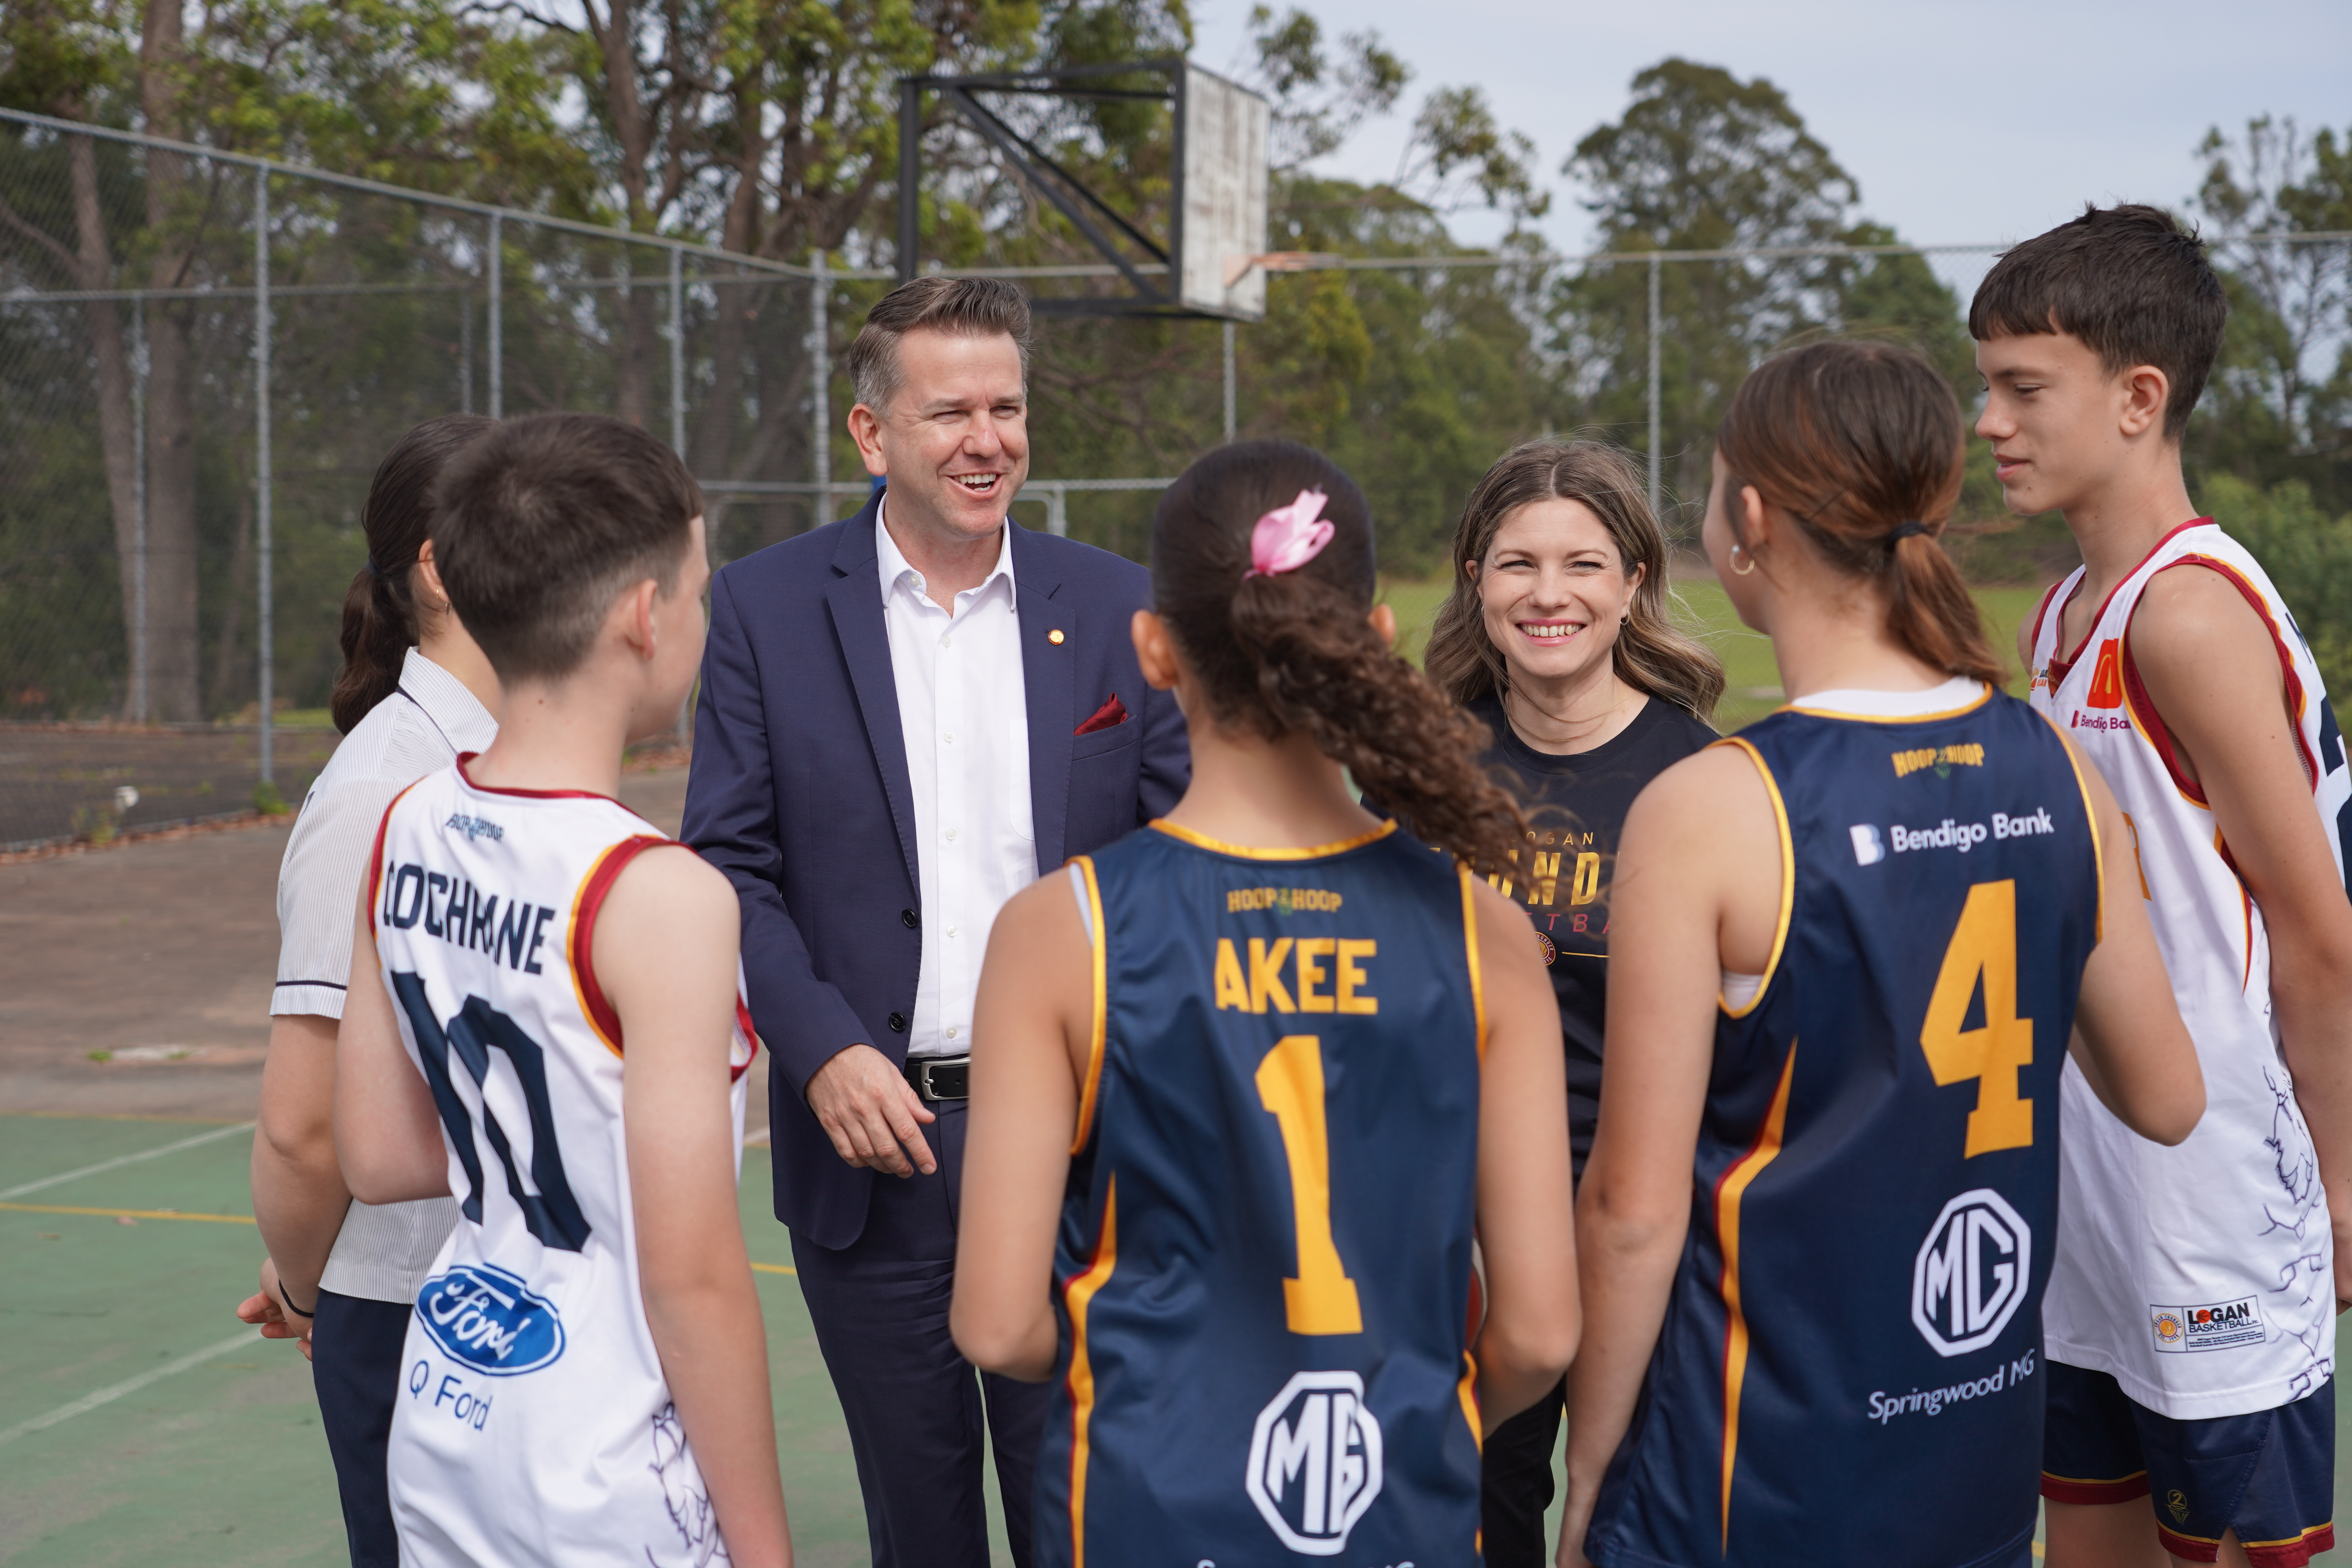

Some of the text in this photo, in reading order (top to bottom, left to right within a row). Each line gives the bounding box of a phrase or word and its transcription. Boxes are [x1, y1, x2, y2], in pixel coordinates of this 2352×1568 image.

[1890, 818, 1987, 853] Bendigo
[1991, 806, 2055, 840] Bank
[1214, 937, 1378, 1015] AKEE
[1534, 933, 1554, 951] HUNDER
[1919, 878, 2033, 1160] 4
[390, 970, 592, 1253] 10
[1255, 1034, 1363, 1336] 1
[1925, 1208, 2014, 1337] MG
[431, 1274, 532, 1360] Ford
[410, 1359, 493, 1432] Q Ford
[1867, 1348, 2035, 1425] Springwood MG
